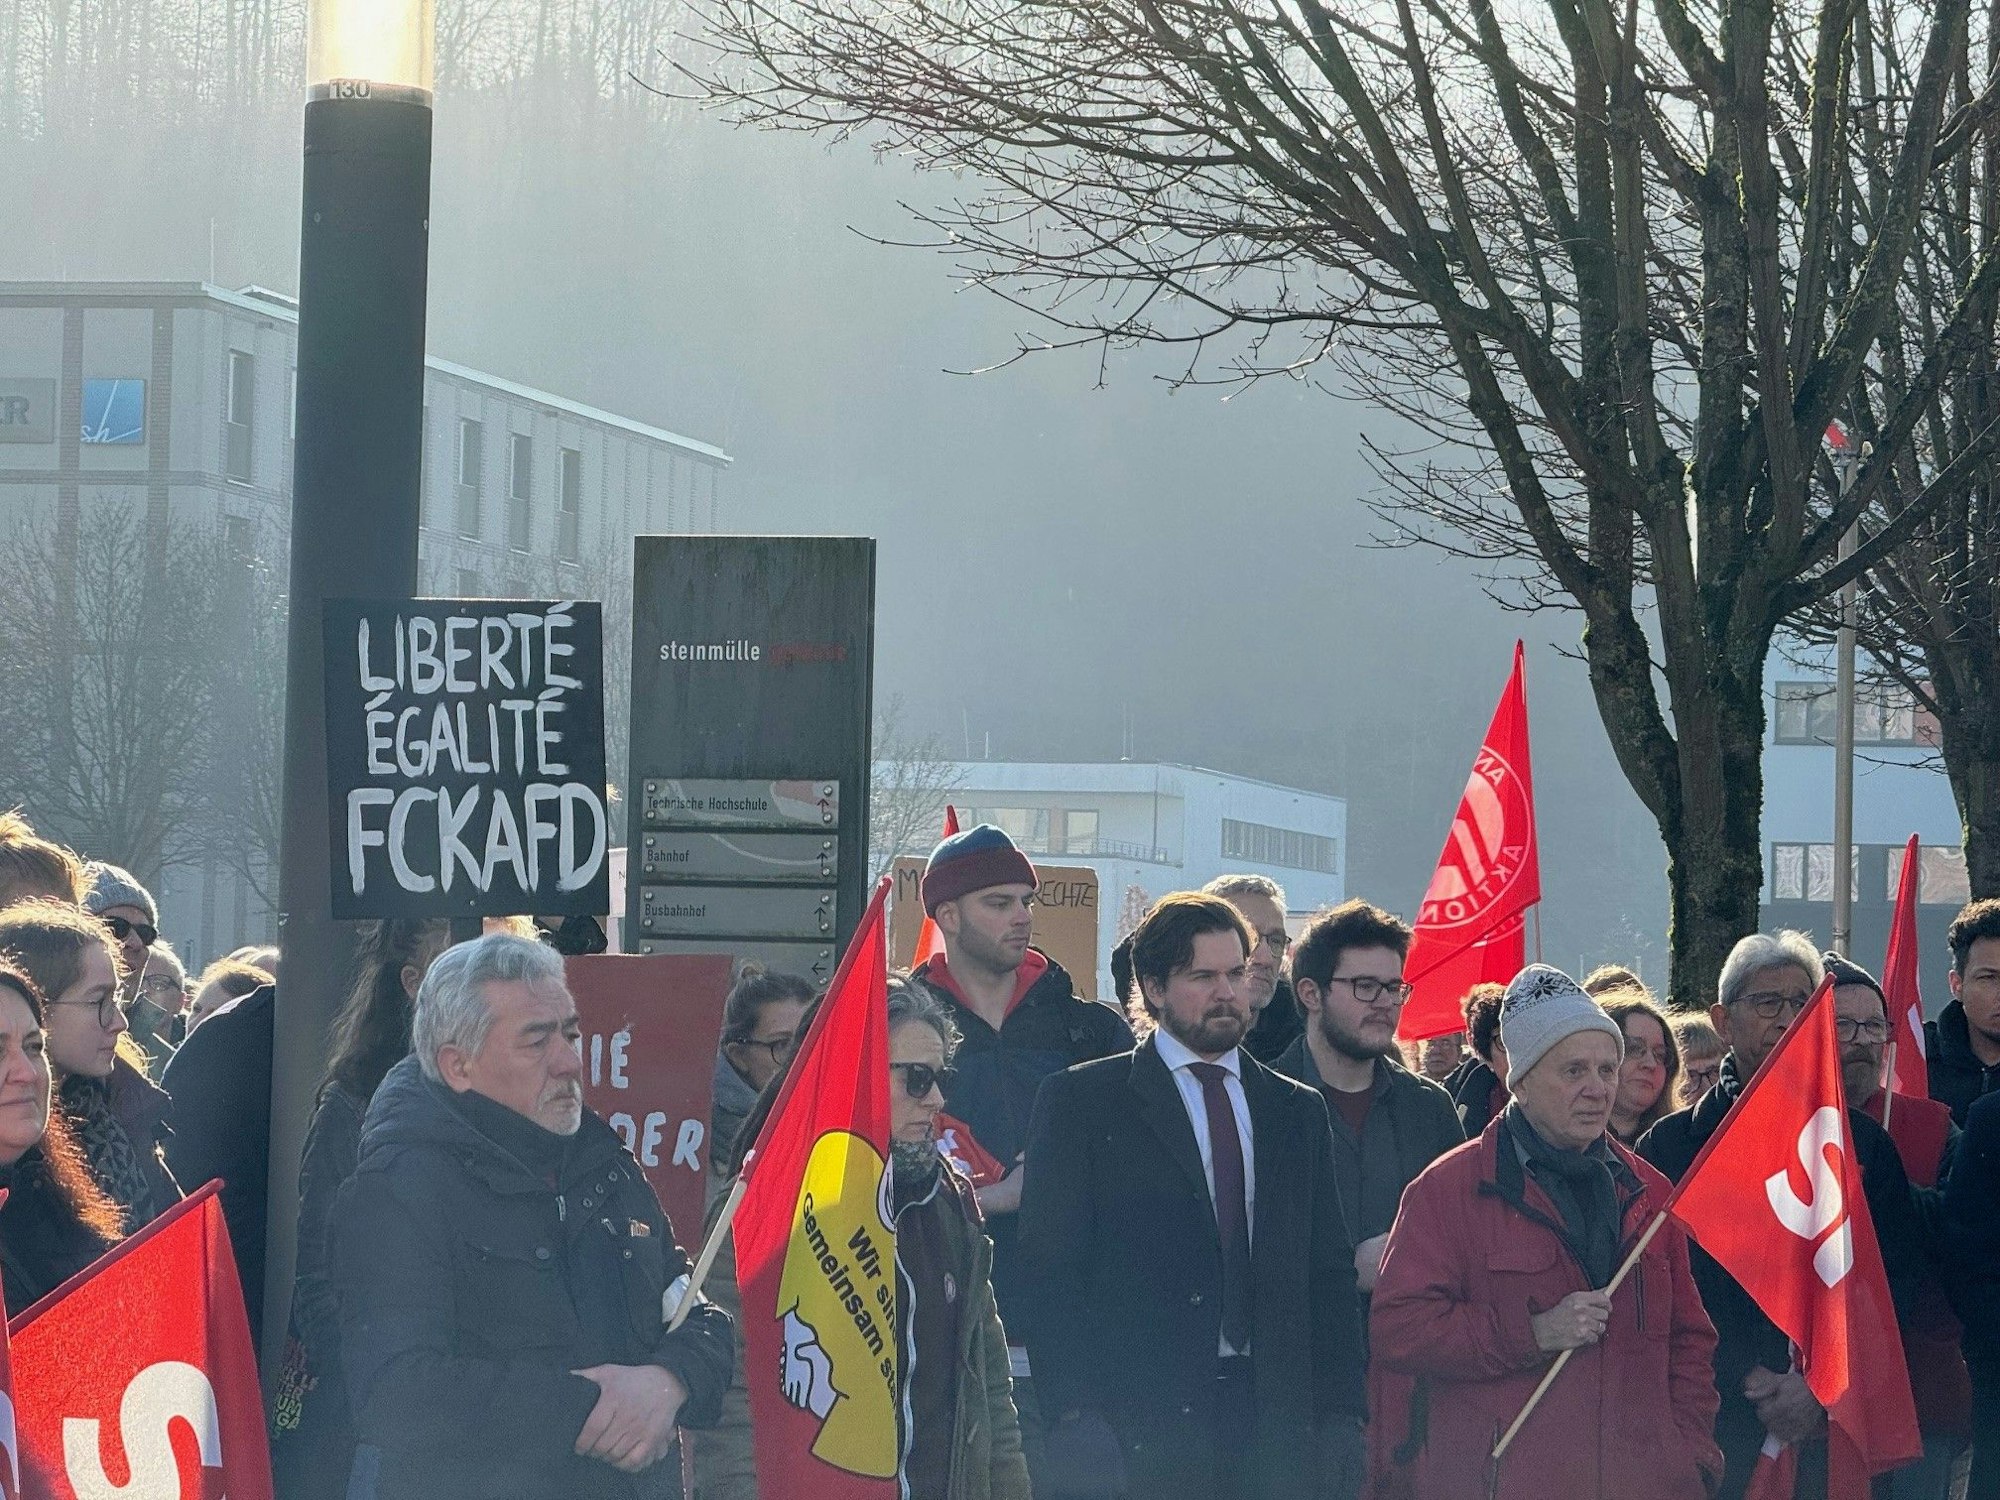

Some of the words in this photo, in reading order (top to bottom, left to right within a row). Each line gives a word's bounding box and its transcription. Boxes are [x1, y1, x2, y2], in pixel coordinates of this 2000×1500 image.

[332, 81, 370, 98] 130
[358, 600, 583, 694] LIBERTÉ
[364, 687, 570, 778] ÉGALITÉ
[648, 797, 704, 810] Technische
[708, 797, 768, 811] Hochschule
[647, 850, 690, 862] Bahnhof
[898, 868, 925, 902] M
[644, 903, 706, 917] Busbahnhof
[575, 1031, 631, 1089] IE
[848, 1225, 882, 1281] Wir
[803, 1192, 884, 1357] Gemeinsam
[880, 1357, 896, 1411] sta
